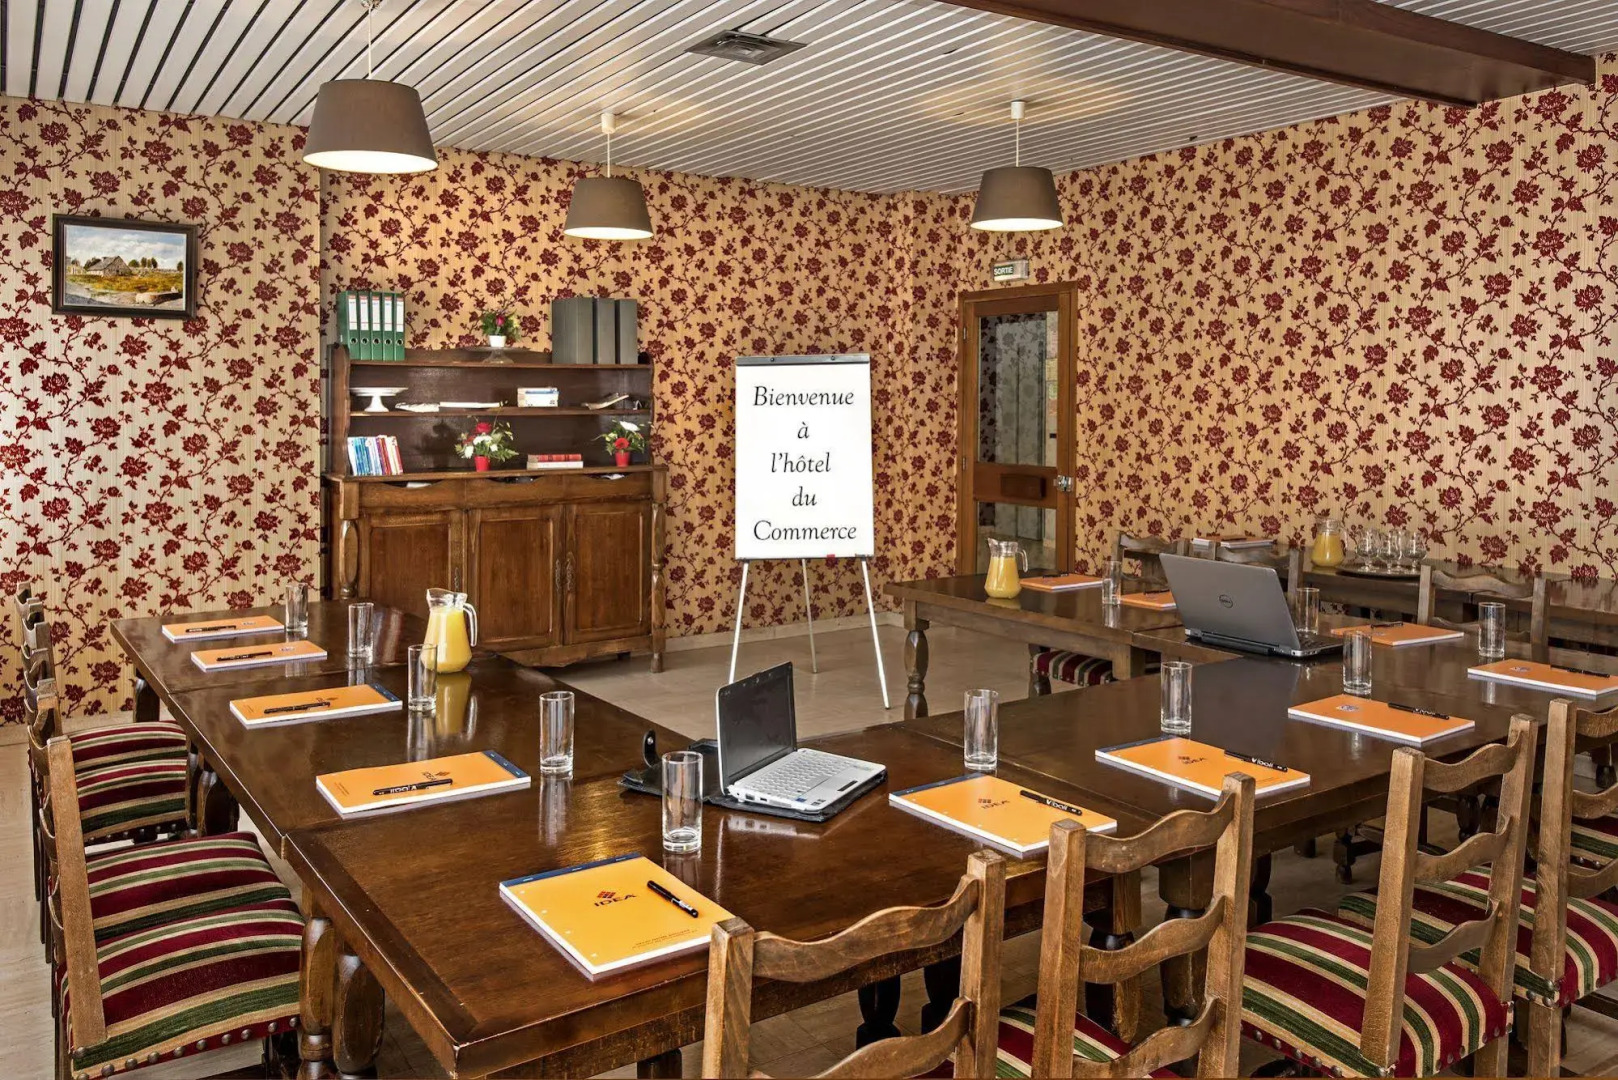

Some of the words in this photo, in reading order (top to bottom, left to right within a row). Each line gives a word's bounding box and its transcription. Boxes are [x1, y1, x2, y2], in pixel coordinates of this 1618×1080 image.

[994, 266, 1013, 275] SORTIE
[753, 386, 854, 406] Bienvenue
[797, 421, 809, 439] à
[771, 452, 831, 473] l’hôtel
[792, 486, 817, 506] du
[753, 520, 857, 540] Commerce
[594, 894, 637, 906] IDEA
